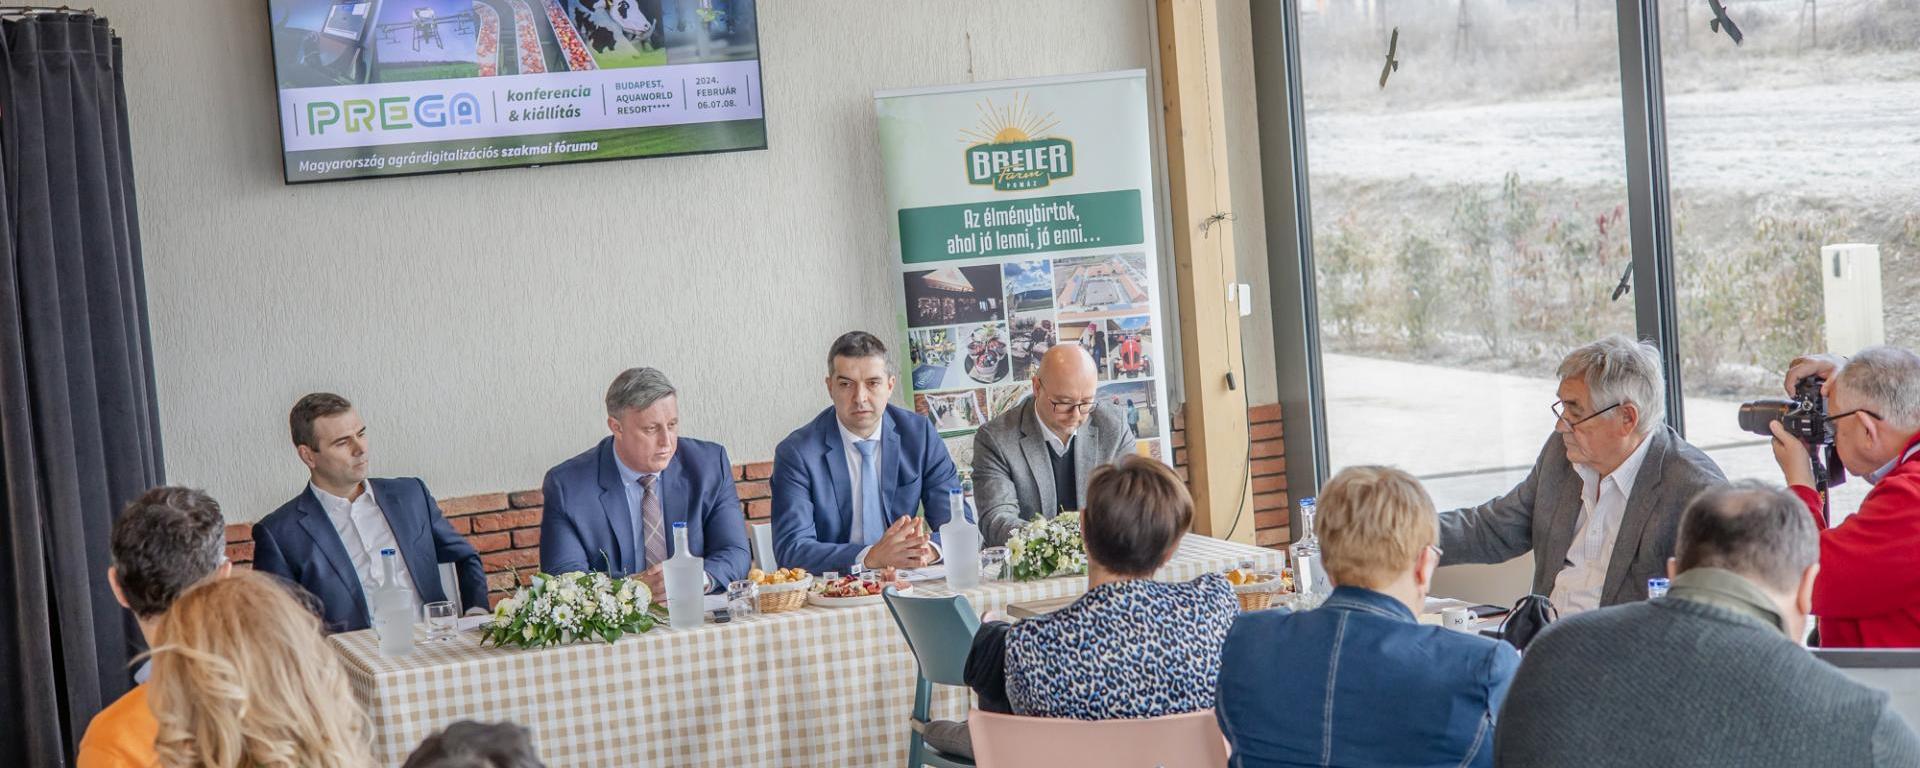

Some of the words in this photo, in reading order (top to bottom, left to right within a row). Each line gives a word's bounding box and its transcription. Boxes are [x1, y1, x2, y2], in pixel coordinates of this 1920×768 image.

[615, 79, 664, 91] BUDAPEST,
[695, 76, 719, 86] 2024.
[507, 84, 592, 102] konferencia
[616, 92, 673, 104] AQUAWORLD
[696, 86, 737, 97] FEBRUÁR
[508, 110, 519, 122] &
[522, 104, 581, 121] kiállítás
[697, 99, 737, 110] 06.07.08.
[307, 92, 481, 136] PREGA
[299, 153, 385, 172] Magyarország
[388, 146, 499, 170] agrárdigitalizációs
[501, 142, 552, 158] szakmai
[554, 141, 599, 155] fóruma
[972, 144, 1068, 180] BREIER
[964, 209, 981, 229] Az
[984, 201, 1080, 227] élménybirtok,
[947, 232, 976, 254] ahol
[979, 230, 993, 255] jó
[996, 228, 1034, 250] lenni,
[1036, 226, 1050, 250] jó
